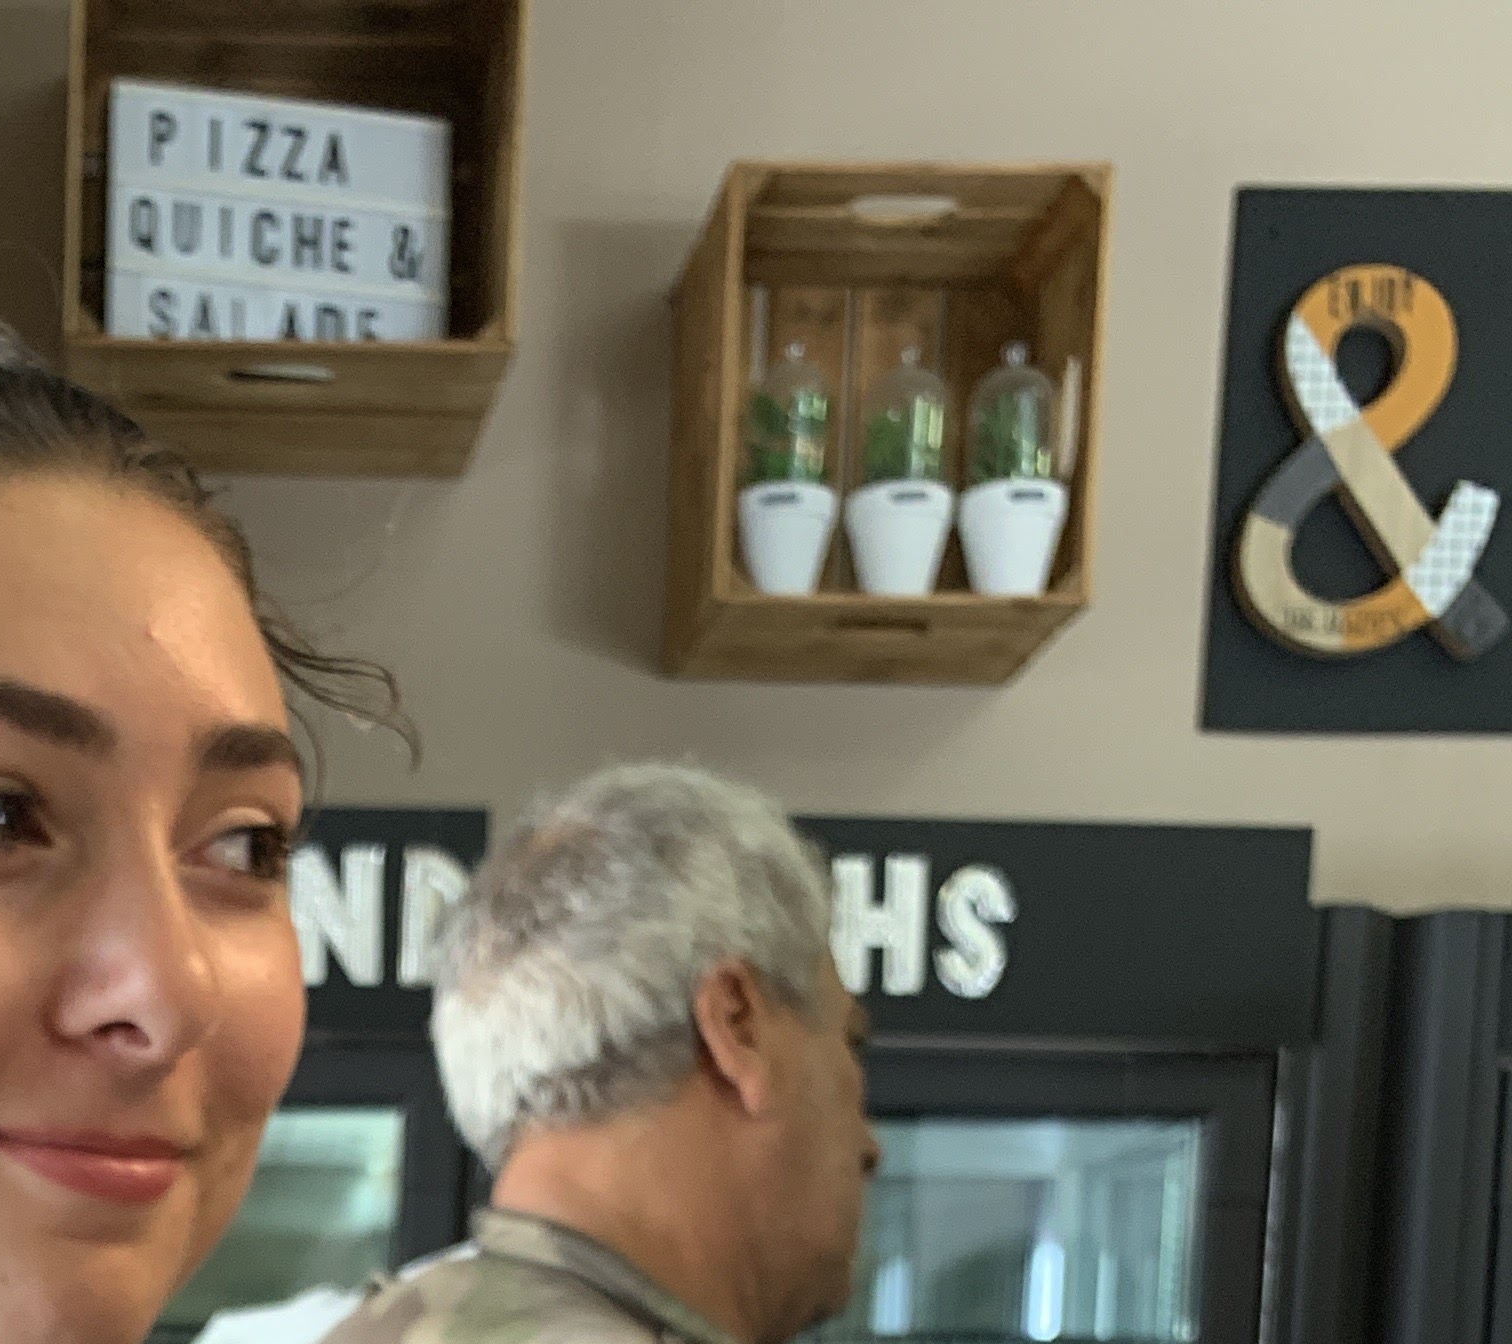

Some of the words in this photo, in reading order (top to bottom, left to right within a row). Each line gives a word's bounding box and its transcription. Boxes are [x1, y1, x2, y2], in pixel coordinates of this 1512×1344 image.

[147, 110, 350, 188] PIZZA
[129, 196, 354, 276] QUICHE
[390, 224, 423, 281] &
